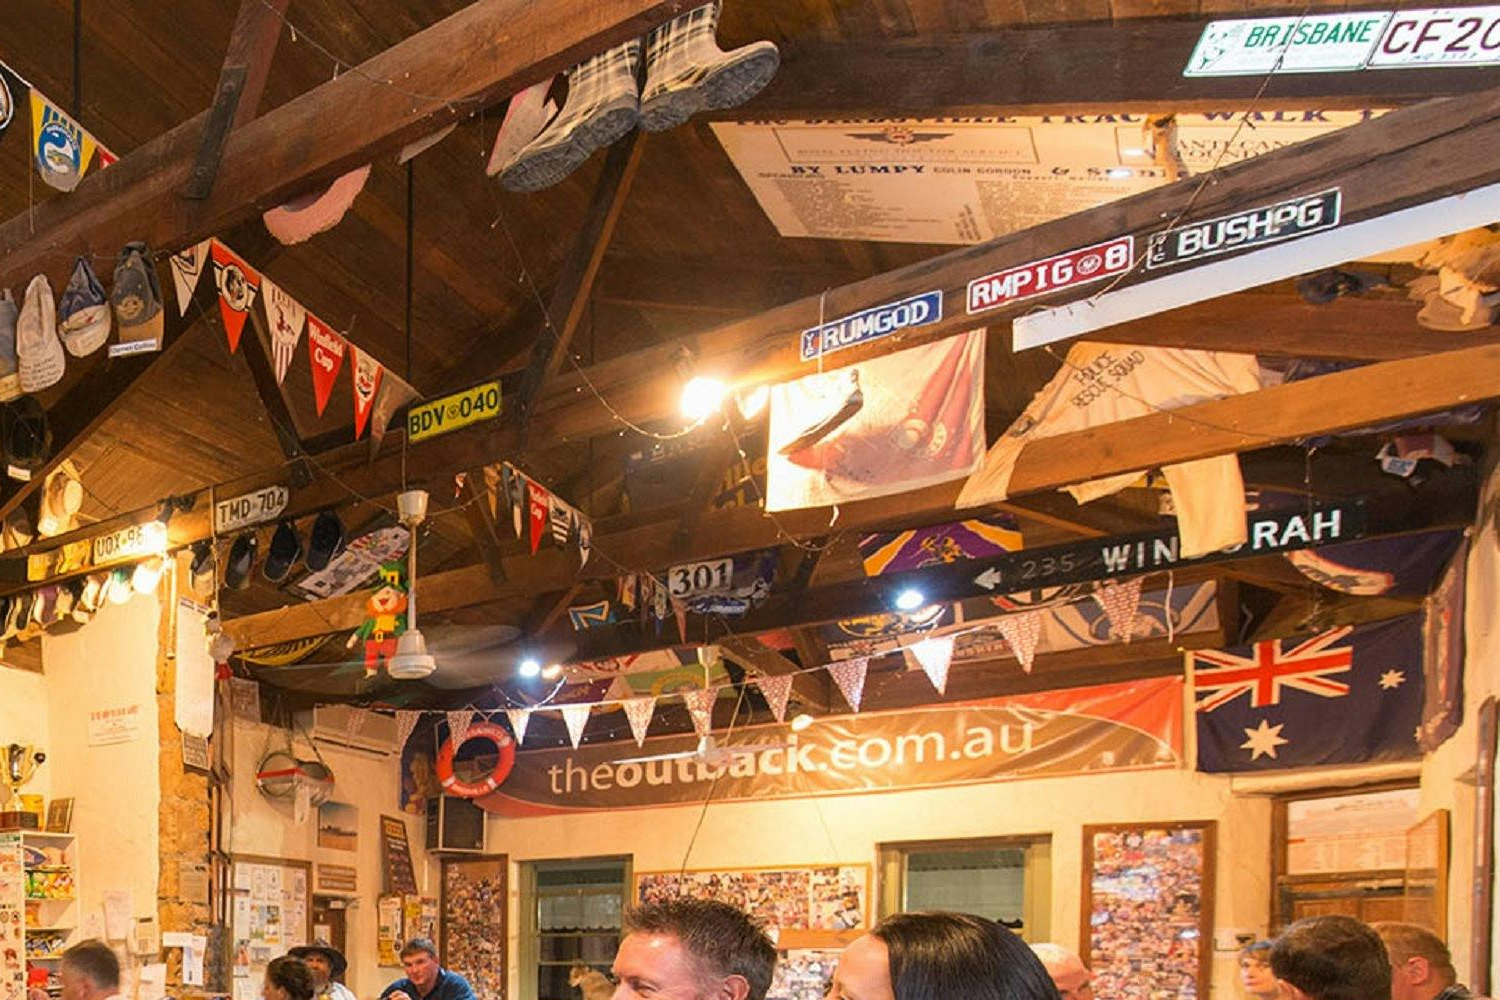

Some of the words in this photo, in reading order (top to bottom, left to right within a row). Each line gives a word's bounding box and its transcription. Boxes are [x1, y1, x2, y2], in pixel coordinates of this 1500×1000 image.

[1244, 20, 1380, 48] BRISBANE
[789, 165, 821, 175] BY
[834, 164, 925, 175] LUMPY
[972, 257, 1073, 309] RMPIG
[1104, 243, 1128, 271] 8
[822, 298, 930, 349] RUMGOD
[314, 347, 334, 372] Cup
[1073, 350, 1118, 386] POLICE
[1108, 350, 1146, 381] SQUAD
[409, 404, 446, 436] BDV
[459, 388, 499, 418] 040
[218, 498, 251, 524] TMD
[1021, 553, 1076, 581] 235
[1102, 509, 1342, 574] WINRAH
[672, 562, 727, 596] 301
